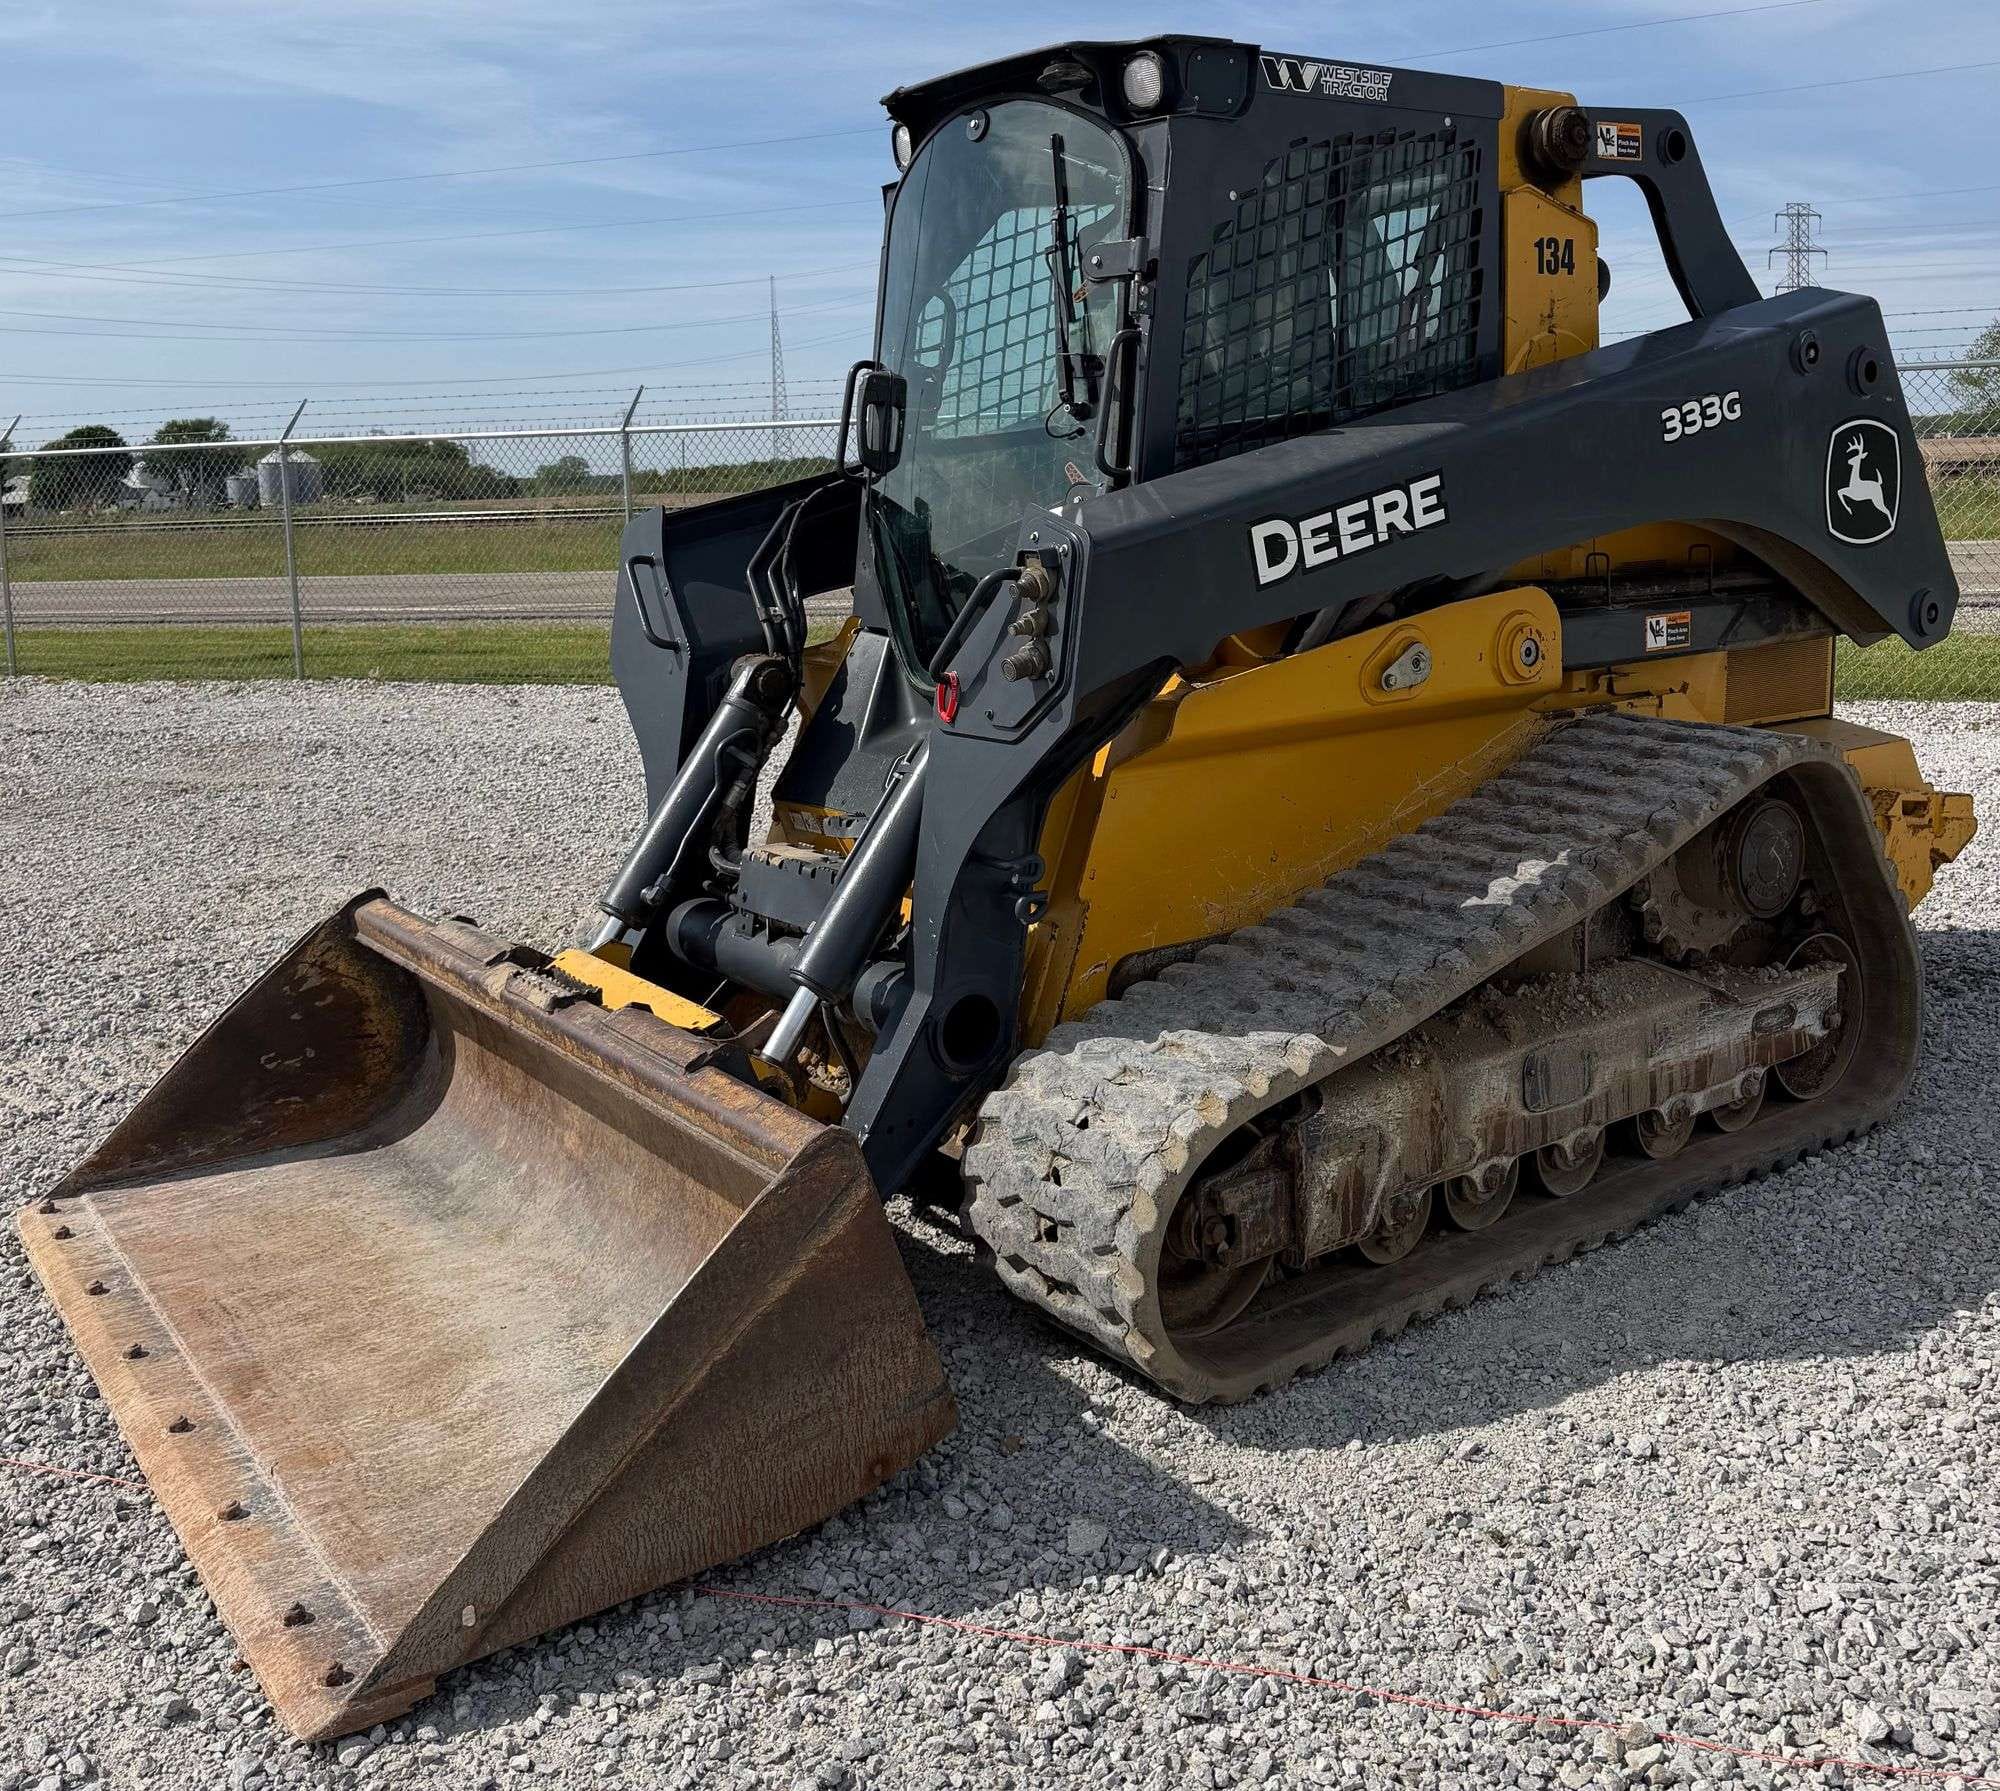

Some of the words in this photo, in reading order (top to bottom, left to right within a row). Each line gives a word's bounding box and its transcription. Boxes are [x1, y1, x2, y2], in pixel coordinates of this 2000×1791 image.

[1320, 64, 1359, 83] WEST
[1360, 70, 1392, 87] SIDE
[1321, 79, 1388, 101] TRACTOR
[1534, 237, 1575, 275] 134
[1661, 391, 1742, 442] 333G
[1251, 474, 1446, 585] DEERE
